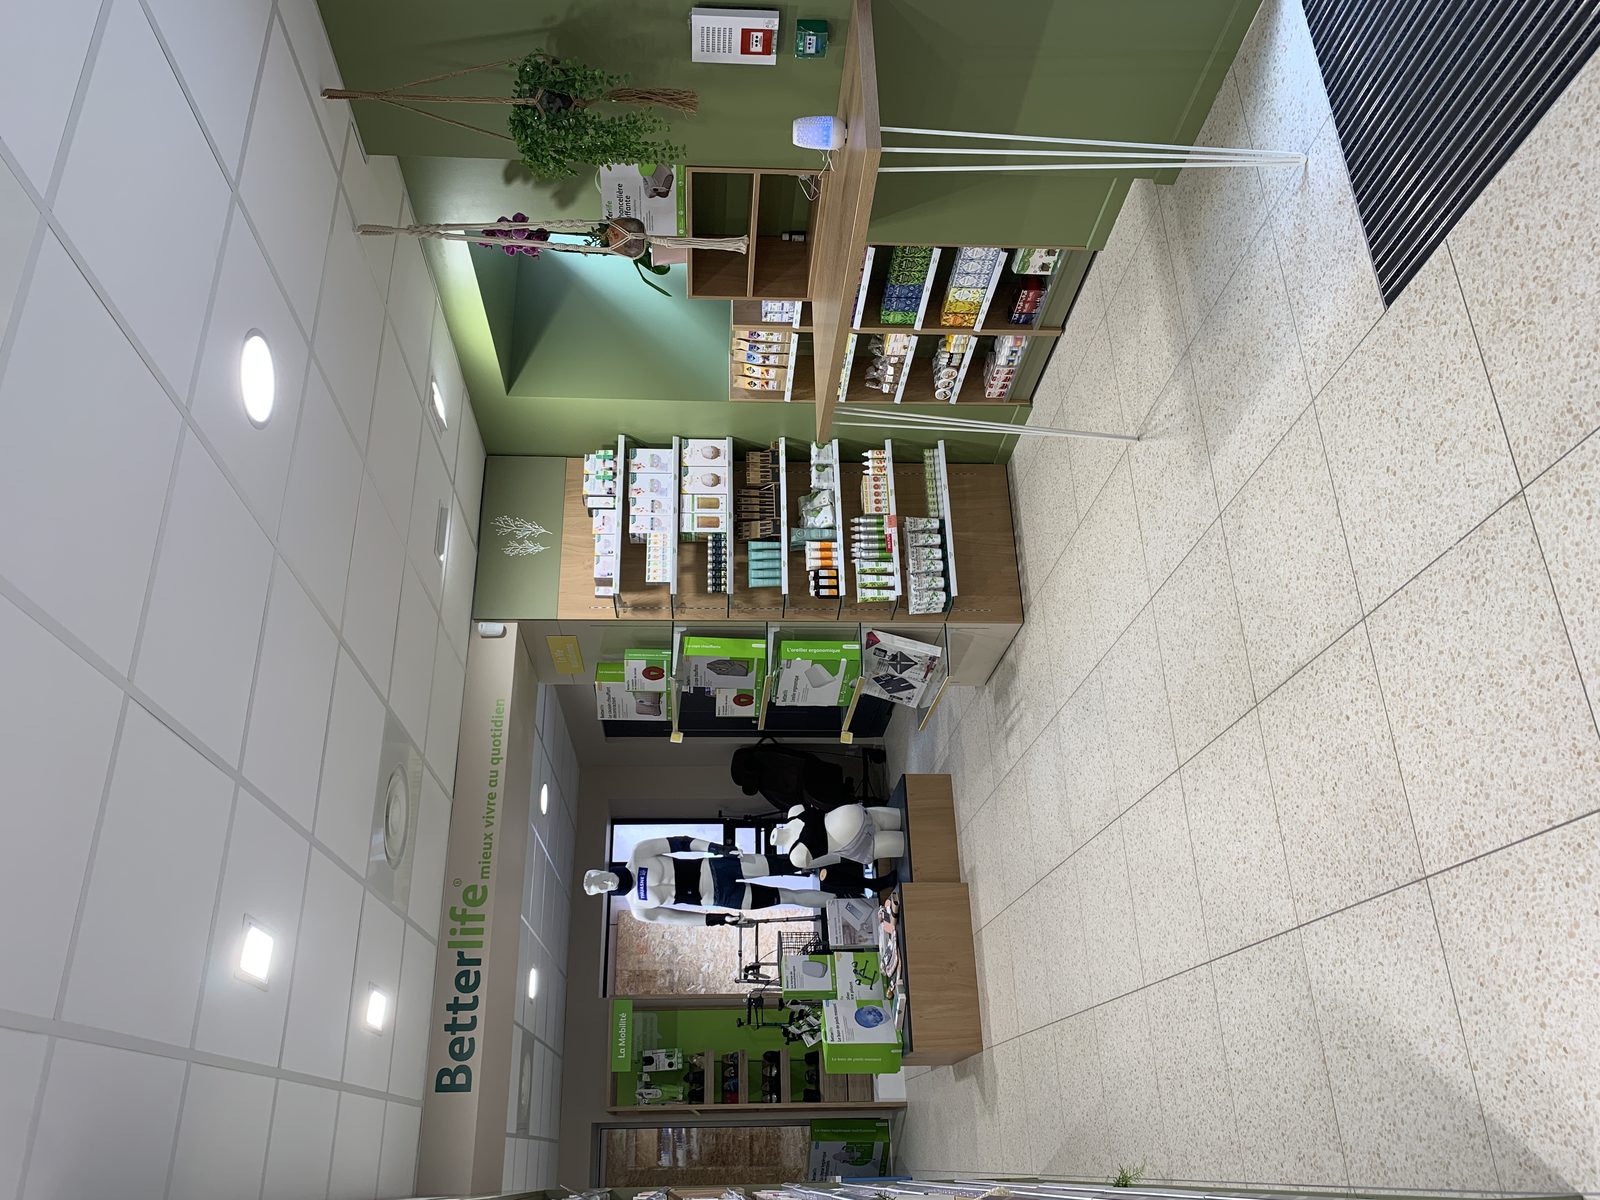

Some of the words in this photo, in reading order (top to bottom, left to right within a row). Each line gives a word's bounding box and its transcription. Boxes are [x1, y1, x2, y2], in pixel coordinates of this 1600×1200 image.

[490, 698, 504, 765] quotidien
[488, 769, 499, 788] au
[482, 792, 498, 828] vivre
[479, 832, 494, 880] mieux
[618, 1012, 627, 1046] Mobilité
[617, 1048, 626, 1058] La
